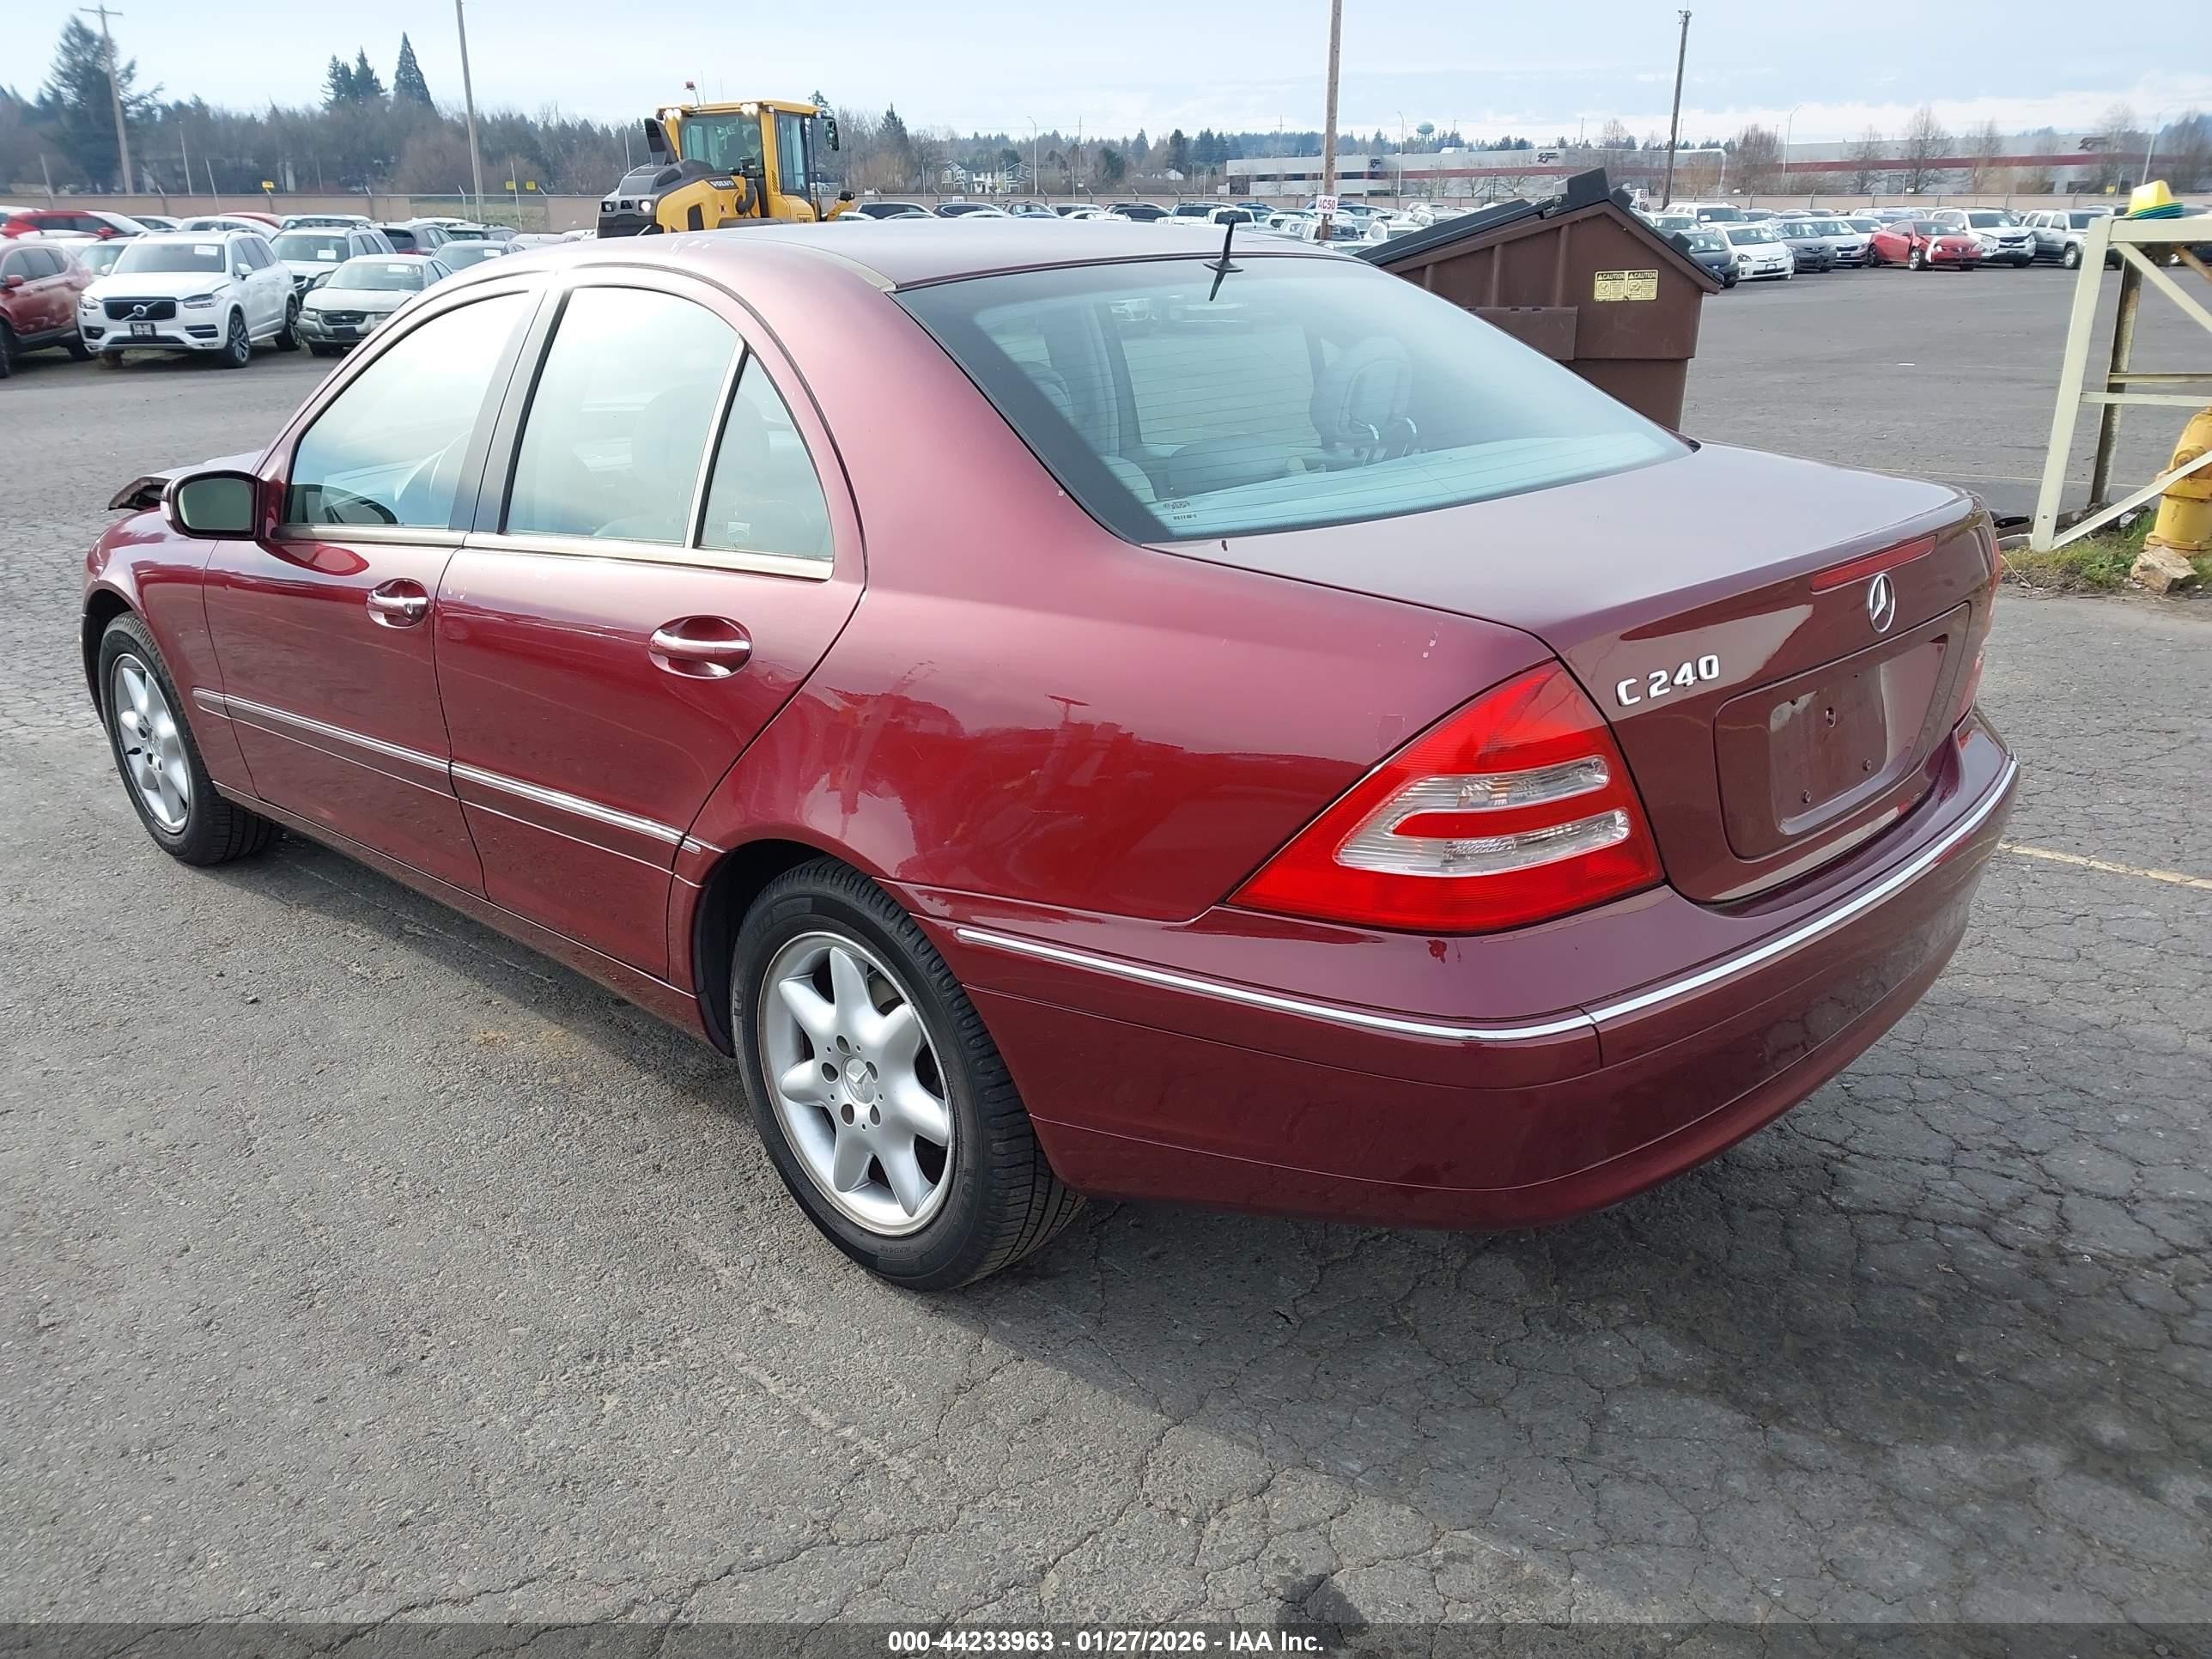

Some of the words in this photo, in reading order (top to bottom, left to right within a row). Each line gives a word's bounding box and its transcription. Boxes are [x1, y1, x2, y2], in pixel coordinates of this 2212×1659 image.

[1318, 198, 1336, 210] AC50
[1615, 678, 1642, 706] C
[1647, 654, 1720, 698] 240
